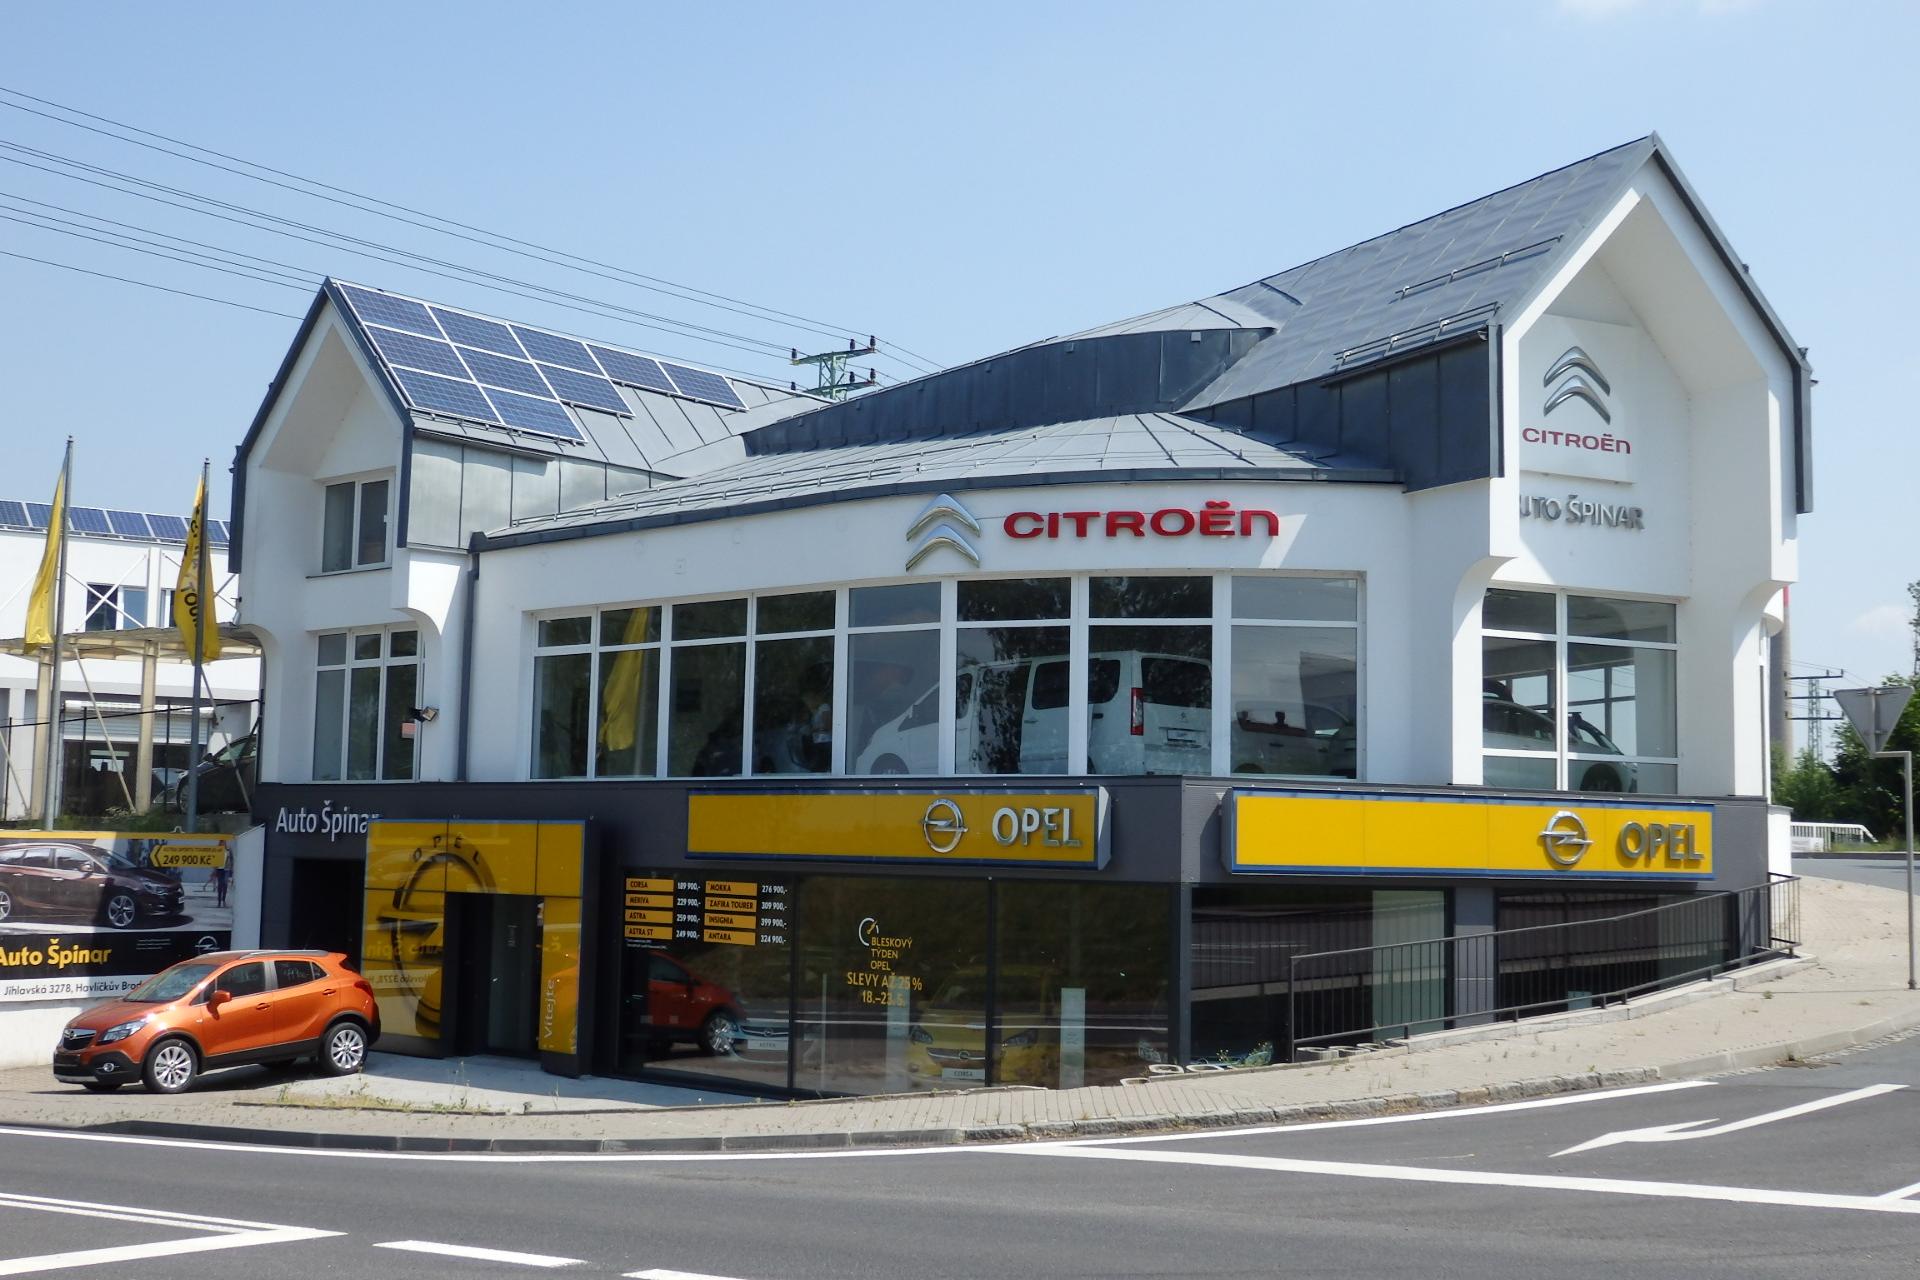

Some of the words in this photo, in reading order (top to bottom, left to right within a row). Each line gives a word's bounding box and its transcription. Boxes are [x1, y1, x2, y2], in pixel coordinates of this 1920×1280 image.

[1519, 495, 1563, 521] UTO
[1565, 494, 1646, 530] ŠPINAR
[275, 806, 318, 834] Auto
[991, 807, 1082, 847] OPEL
[1620, 821, 1705, 861] OPEL
[163, 855, 180, 865] 249
[181, 855, 199, 865] 900
[630, 880, 648, 889] CORSA
[710, 883, 731, 892] MOKKA
[629, 896, 649, 905] MERIVA
[709, 900, 730, 909] ZAFIRA
[731, 901, 754, 910] TOURER
[629, 911, 646, 920] ASTRA
[708, 916, 734, 925] INSIGNIA
[628, 928, 646, 936] ASTRA
[708, 932, 732, 941] ANTARA
[871, 937, 912, 948] BLESKOVÝ
[0, 946, 42, 966] Auto
[47, 938, 112, 970] Špinar
[871, 946, 899, 959] TÝDEN
[870, 960, 891, 971] OPEL
[847, 971, 879, 987] SLEVY
[4, 984, 47, 996] Jihlavská
[49, 983, 73, 994] 3278,
[76, 981, 119, 993] Havlíčkův
